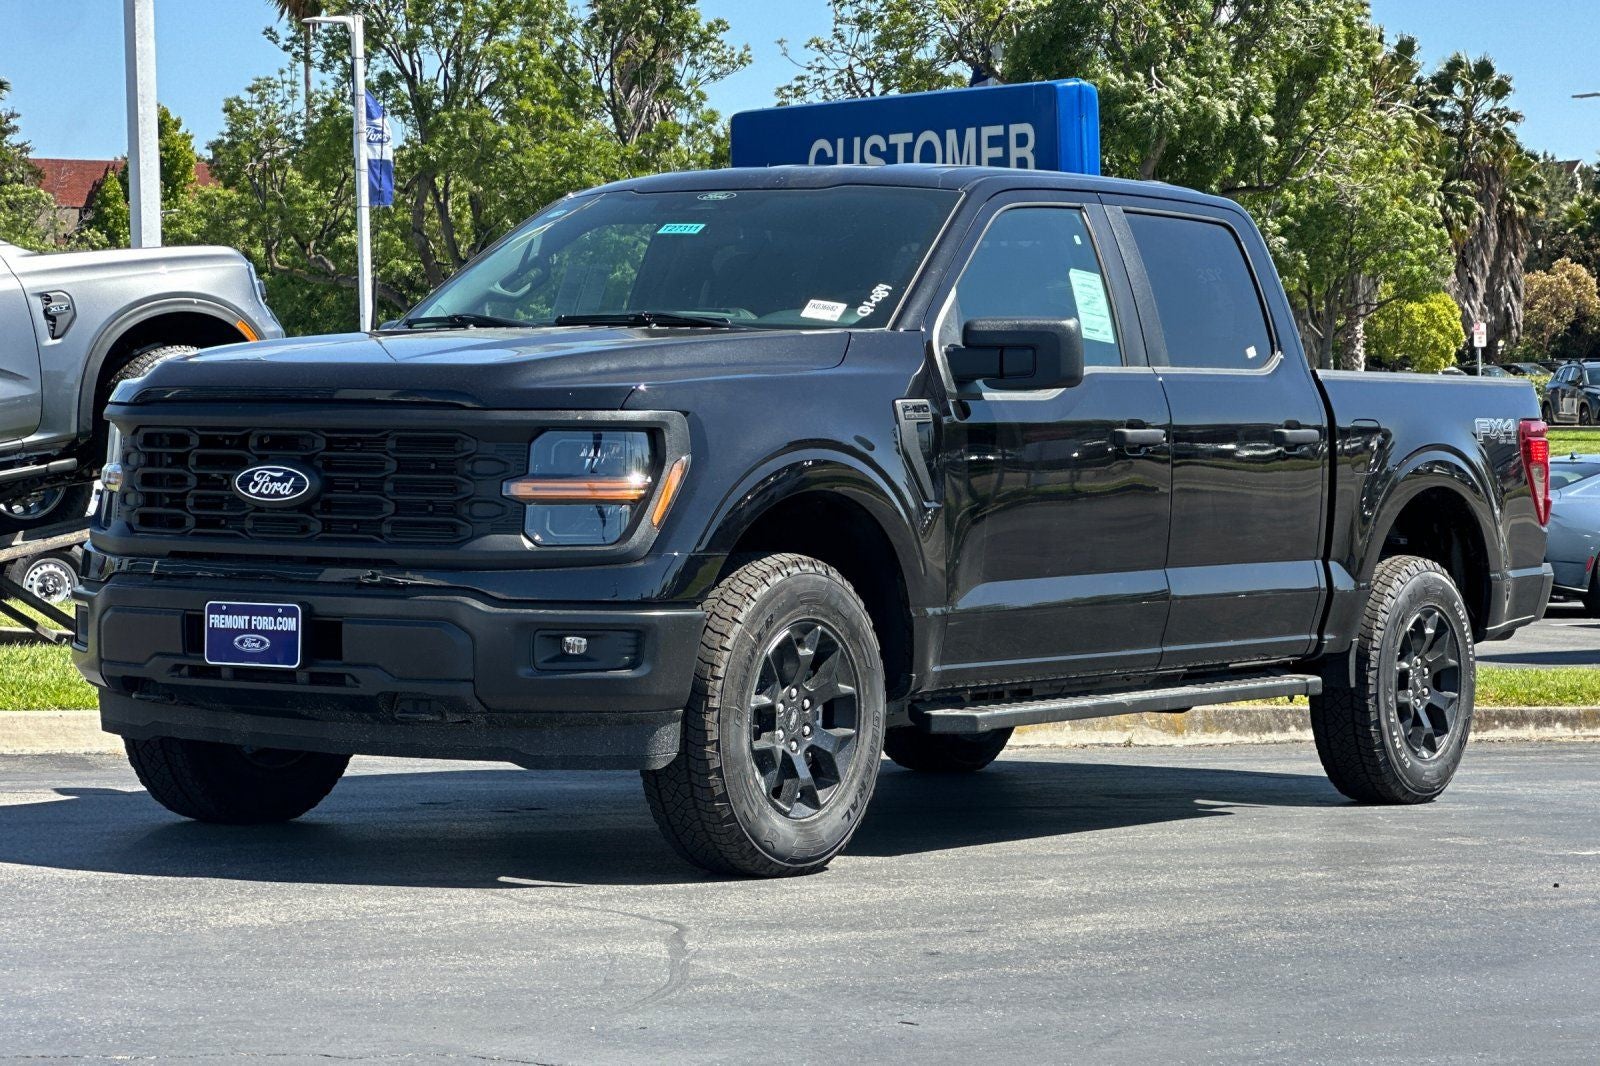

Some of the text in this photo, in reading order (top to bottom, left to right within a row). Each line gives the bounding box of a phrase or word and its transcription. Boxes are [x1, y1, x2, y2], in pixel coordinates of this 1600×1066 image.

[50, 304, 69, 312] XLT
[1475, 417, 1517, 443] FX4
[249, 469, 295, 495] Ford
[209, 614, 297, 632] FREMONT FORD.COM
[243, 637, 261, 648] Ford
